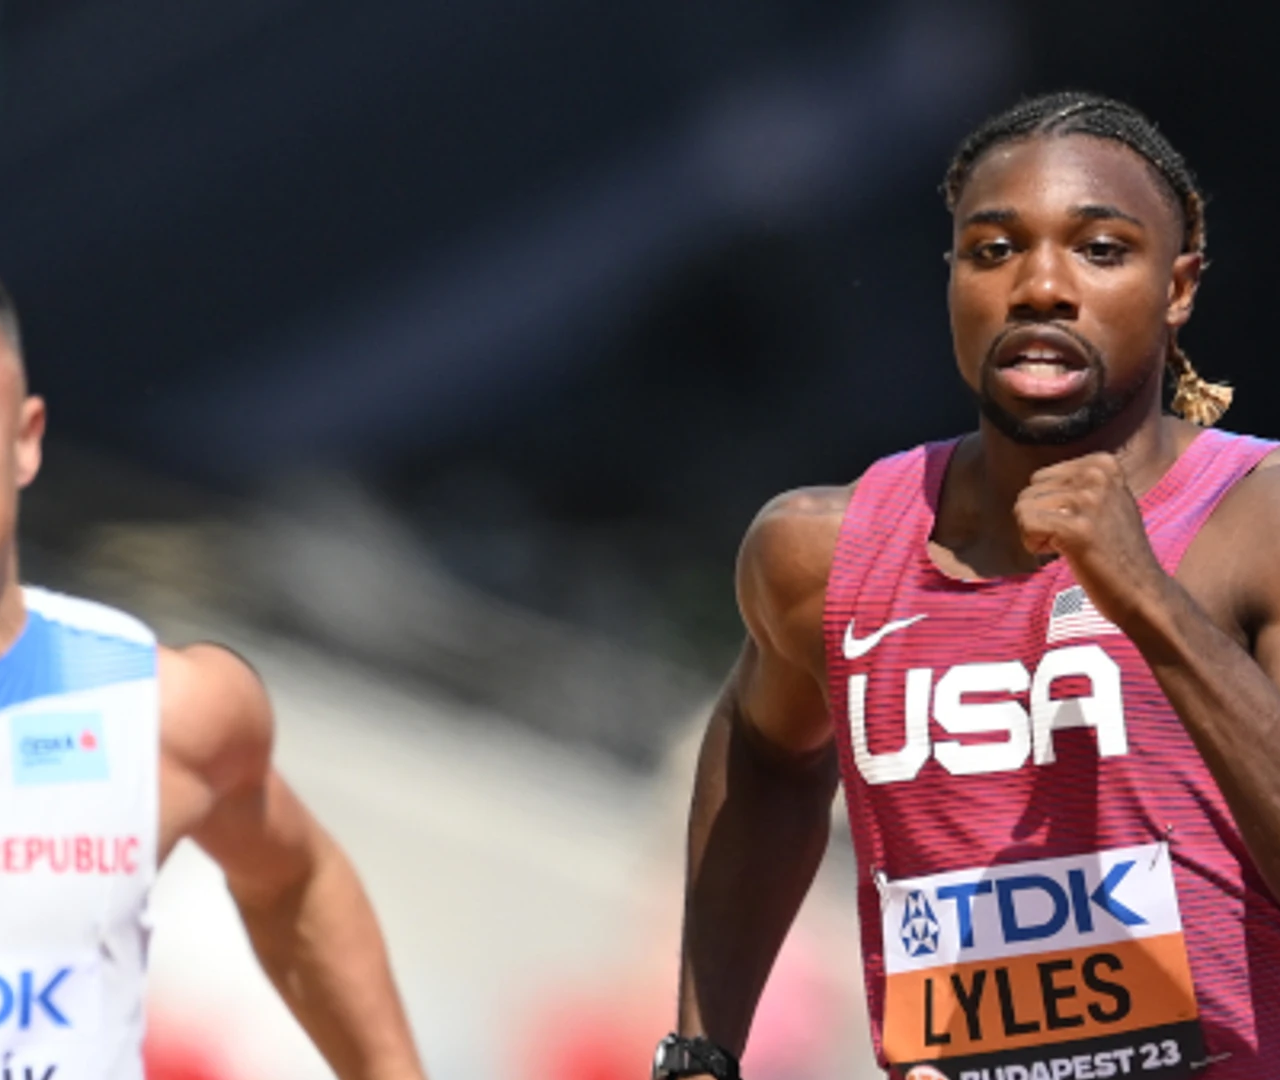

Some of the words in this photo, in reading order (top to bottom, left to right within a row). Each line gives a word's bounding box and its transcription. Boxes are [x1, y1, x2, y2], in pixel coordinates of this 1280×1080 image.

[848, 644, 1128, 785] USA
[936, 860, 1149, 949] TDK
[924, 952, 1132, 1047] LYLES
[1140, 1040, 1181, 1069] 23
